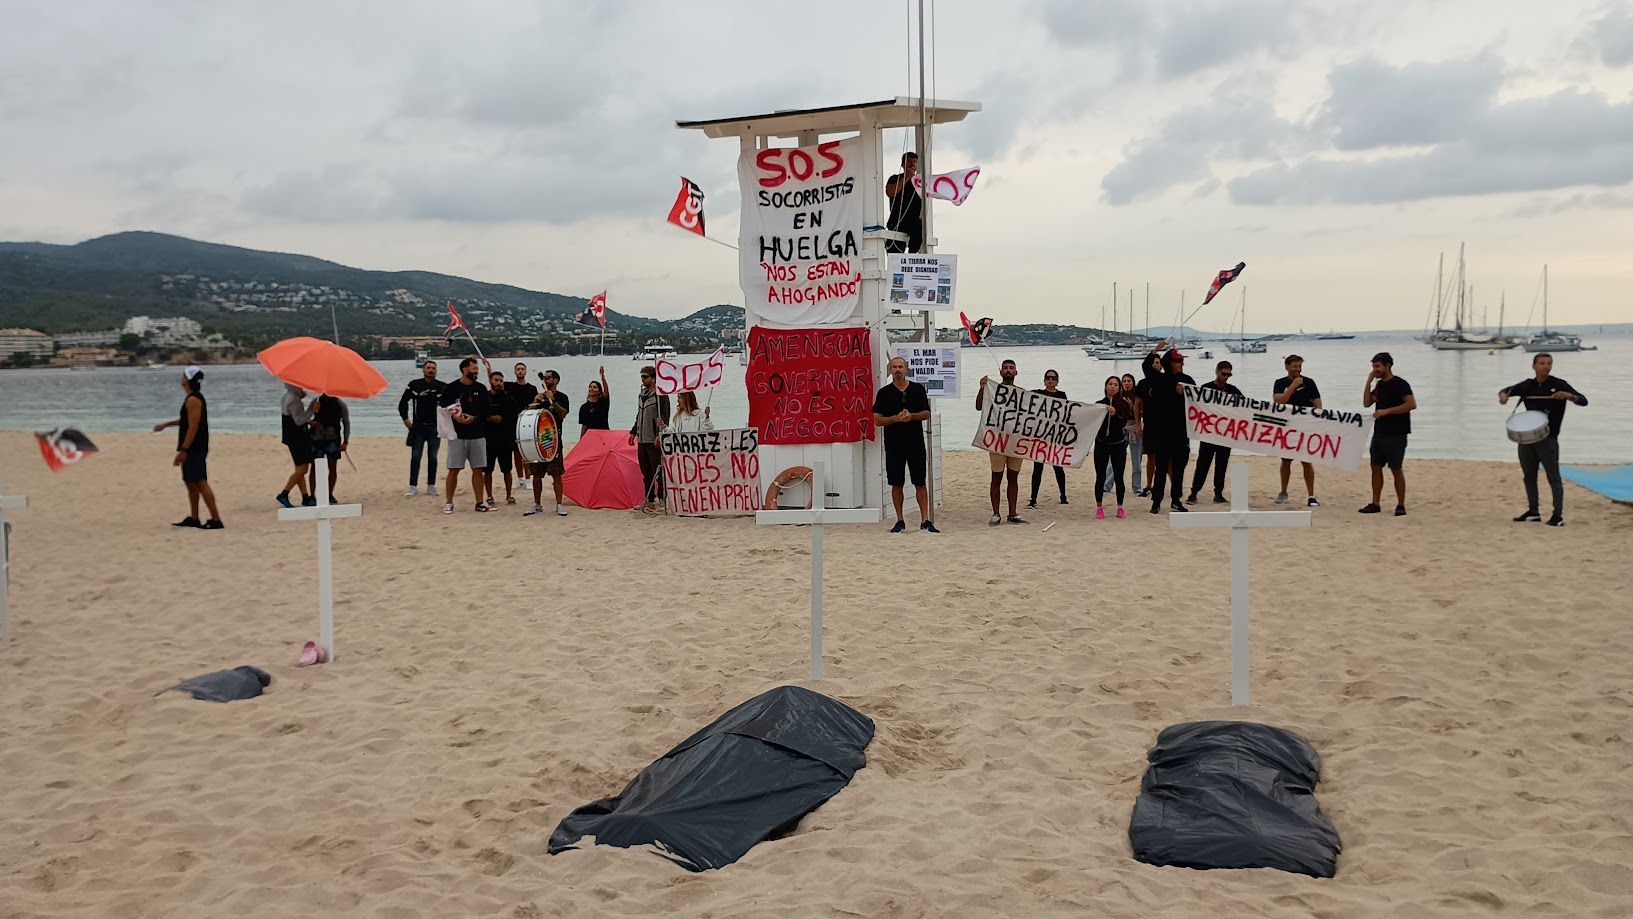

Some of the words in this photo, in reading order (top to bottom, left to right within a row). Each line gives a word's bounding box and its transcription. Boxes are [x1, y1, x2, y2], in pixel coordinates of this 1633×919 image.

[756, 141, 844, 187] S.O.S
[758, 177, 854, 208] SOCORRISTAS
[793, 210, 823, 229] EN
[759, 230, 858, 265] HUELGA
[807, 260, 850, 281] ESTAN
[753, 332, 871, 366] AMENGUAL
[910, 358, 923, 366] NOS
[925, 358, 939, 366] PIDE
[753, 367, 870, 396] GOVERNAR
[915, 367, 935, 375] VALOR
[773, 396, 801, 416] NO
[842, 391, 868, 415] UN
[994, 383, 1082, 426] BALEARIC
[1184, 384, 1286, 414] AYUNTAMIENTO
[1291, 404, 1307, 416] DE
[1311, 407, 1363, 428] CALVIA
[730, 429, 758, 452] LES
[985, 403, 1078, 446] LIFEGUARD
[1187, 405, 1342, 459] PRECARIZACION
[983, 429, 1009, 453] ON
[1015, 438, 1074, 466] STRIKE
[663, 453, 721, 485] VIDES
[730, 452, 759, 480] NO
